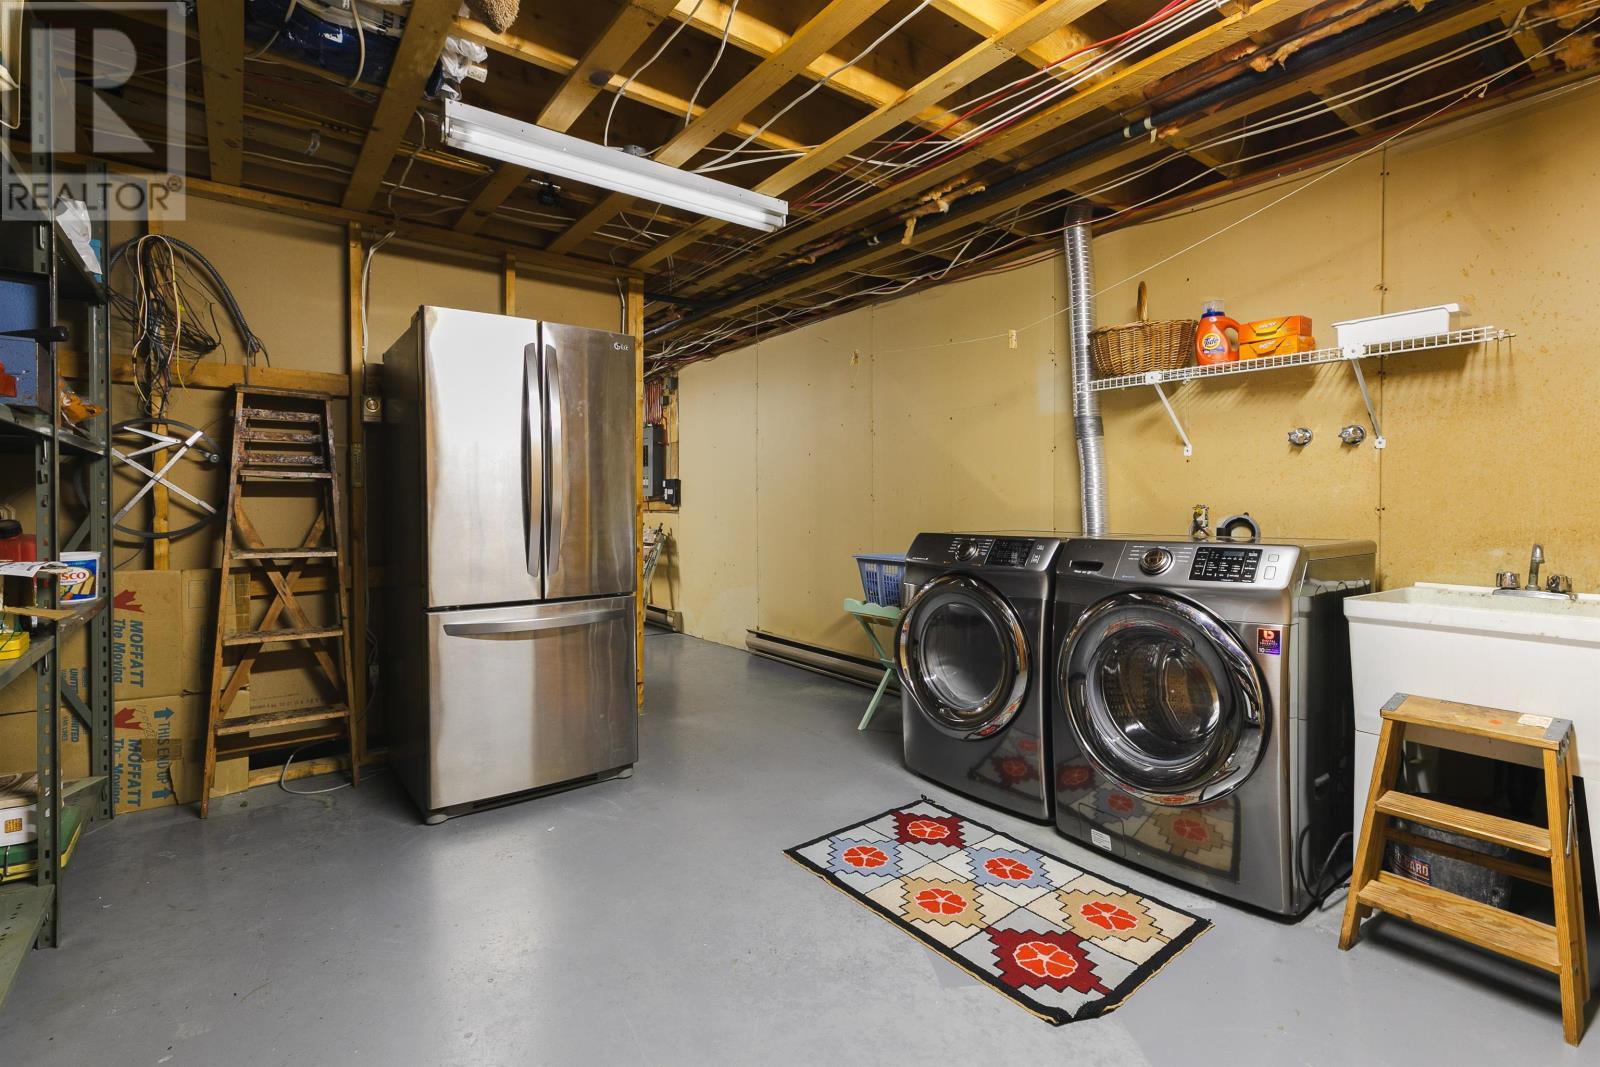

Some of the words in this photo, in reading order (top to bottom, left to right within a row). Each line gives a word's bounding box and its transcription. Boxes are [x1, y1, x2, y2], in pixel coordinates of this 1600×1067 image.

[1204, 336, 1219, 347] Tide
[61, 572, 86, 580] SCO
[112, 619, 125, 639] The
[112, 642, 126, 684] Moving
[129, 620, 144, 688] MOFFATT
[158, 721, 171, 746] THIS
[157, 747, 170, 769] END
[127, 738, 143, 807] MOFFATT
